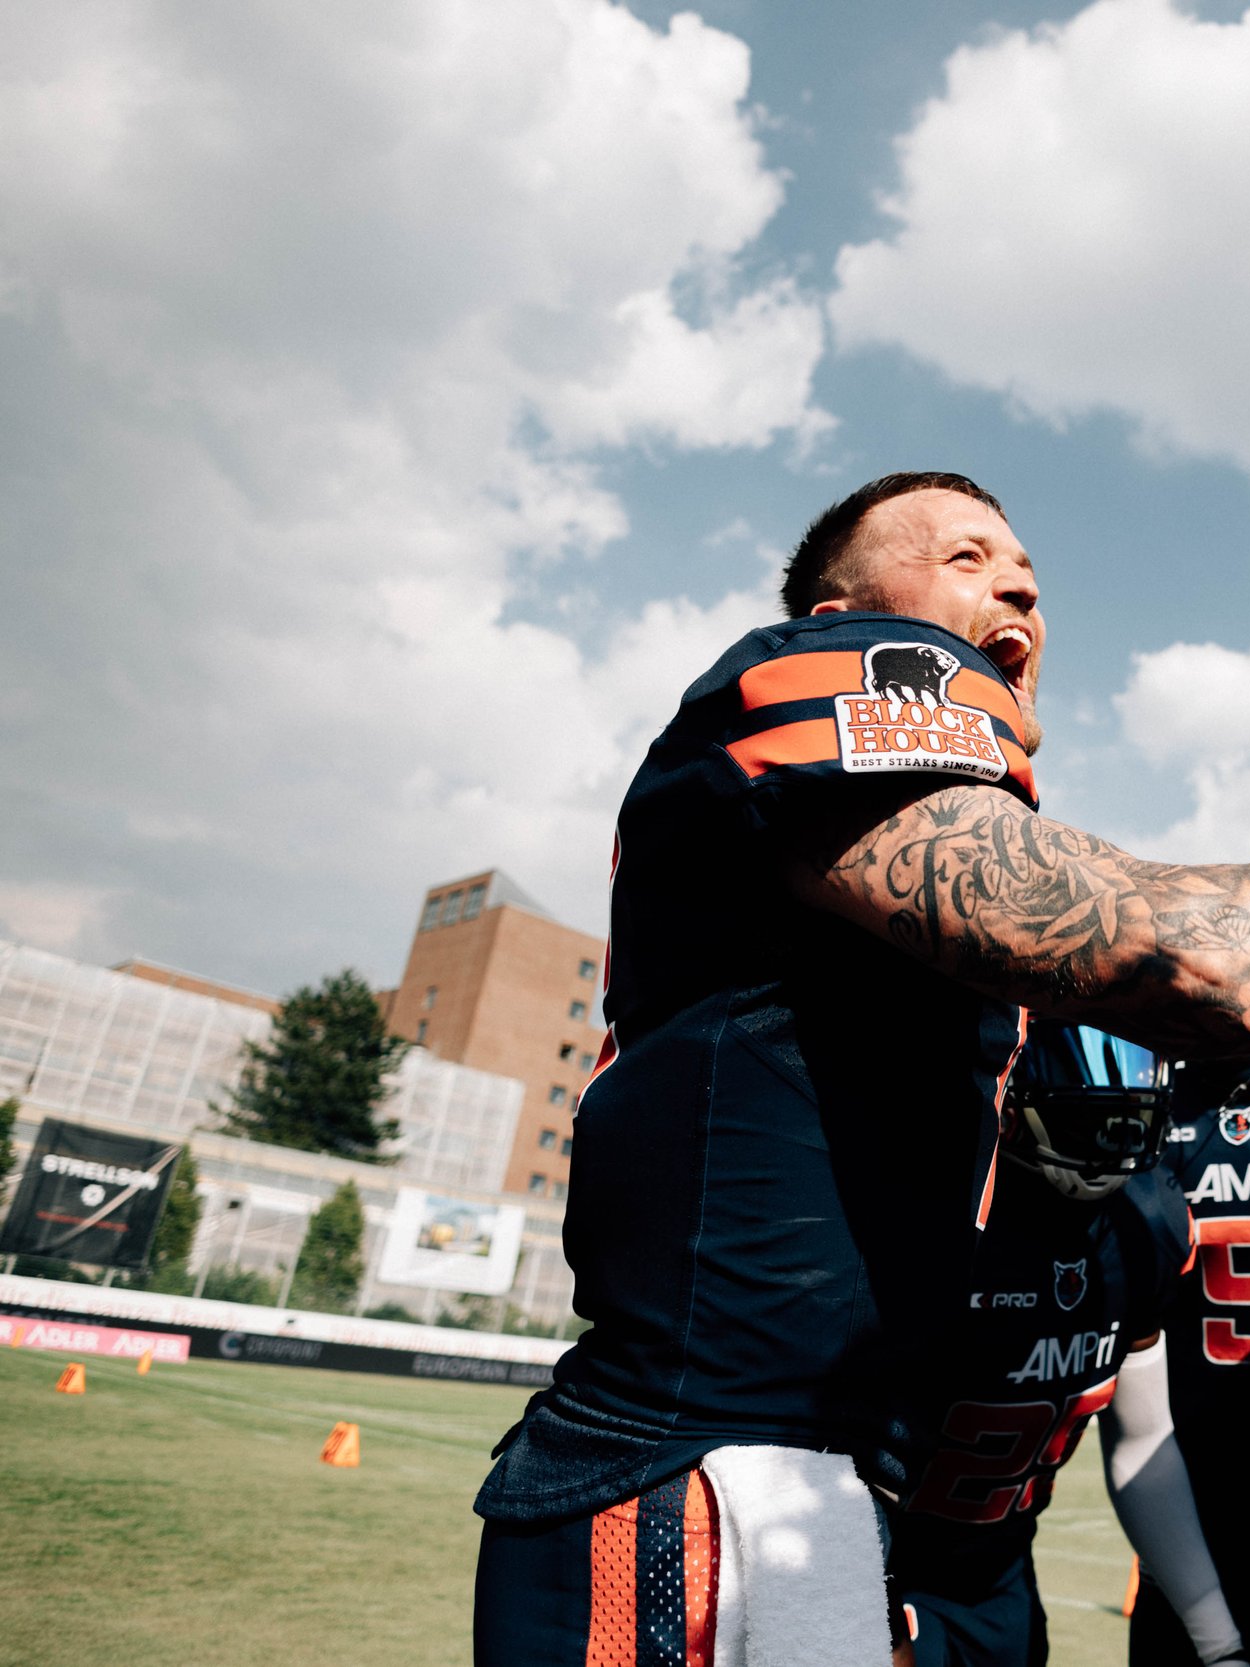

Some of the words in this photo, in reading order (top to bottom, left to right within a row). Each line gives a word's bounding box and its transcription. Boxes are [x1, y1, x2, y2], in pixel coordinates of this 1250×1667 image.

[843, 699, 991, 742] BLOCK
[847, 727, 1002, 766] HOUSE
[852, 758, 883, 767] BEST
[889, 758, 938, 768] STEAKS
[942, 760, 978, 773] SINCE
[980, 767, 999, 779] 1968
[26, 1323, 99, 1351] ADLER
[1007, 1320, 1121, 1384] AMPri
